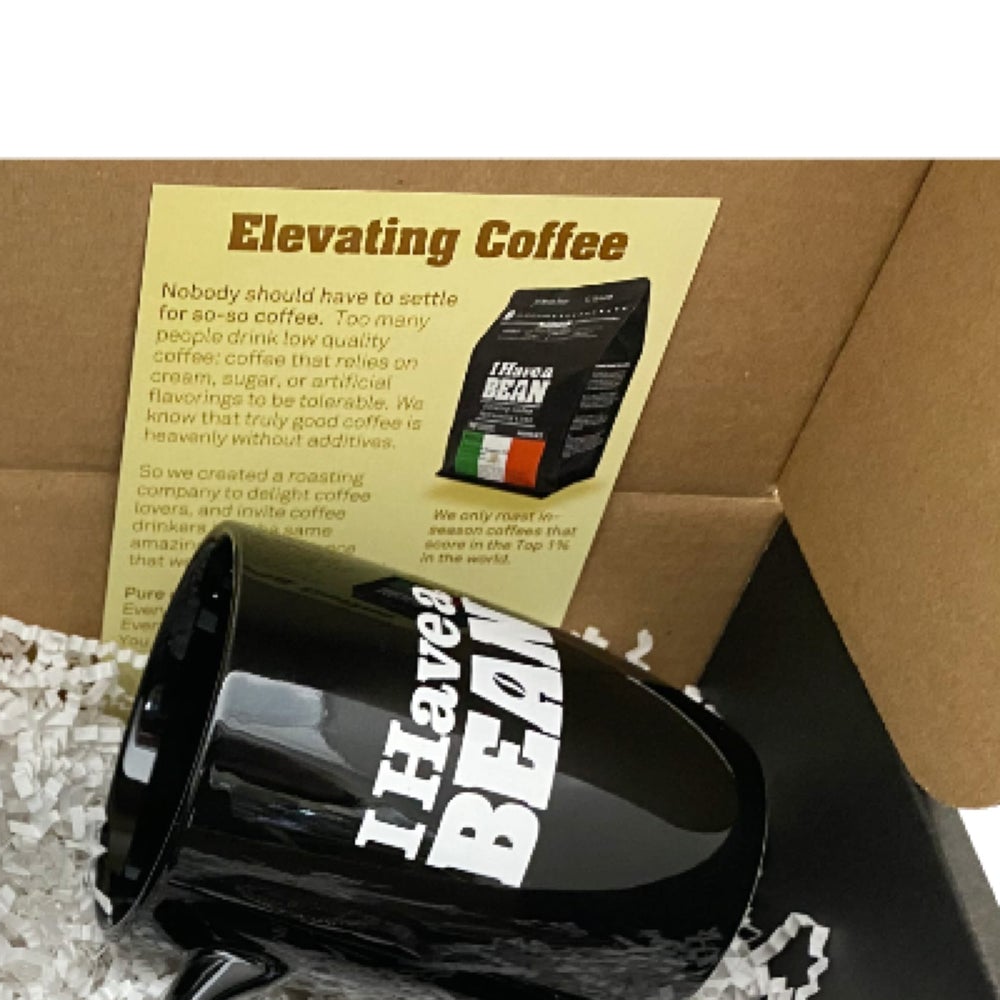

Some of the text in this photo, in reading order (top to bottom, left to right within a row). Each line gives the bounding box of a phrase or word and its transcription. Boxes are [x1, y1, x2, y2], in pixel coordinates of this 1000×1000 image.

[227, 211, 629, 268] Elevating Coffee
[162, 282, 458, 307] Nobody should have to settle
[159, 305, 430, 331] for so-so coffee. Too many
[155, 328, 391, 351] people drink low quality
[152, 350, 418, 370] coffee: coffee that relies on
[150, 371, 392, 391] cream, sugar, or artificial
[482, 377, 551, 403] BEAN
[149, 389, 424, 411] flavorings to be tolerable. We
[146, 408, 423, 431] know that truly good coffee is
[144, 429, 397, 449] heavenly without additives.
[139, 464, 365, 487] So we created a roasting
[137, 486, 371, 504] company to delight coffee
[134, 502, 346, 521] lovers, and invite coffee
[434, 509, 456, 521] We
[460, 510, 493, 523] only
[495, 511, 535, 522] roast
[132, 520, 206, 533] drinkers
[284, 527, 334, 538] same
[428, 525, 577, 536] season coffees that
[424, 539, 570, 552] score in the Top 1%
[129, 554, 164, 567] that
[420, 553, 434, 563] in
[438, 553, 463, 563] the
[124, 587, 166, 600] Pure
[372, 612, 461, 812] Have
[426, 596, 564, 888] BEAN
[355, 809, 427, 861] I
